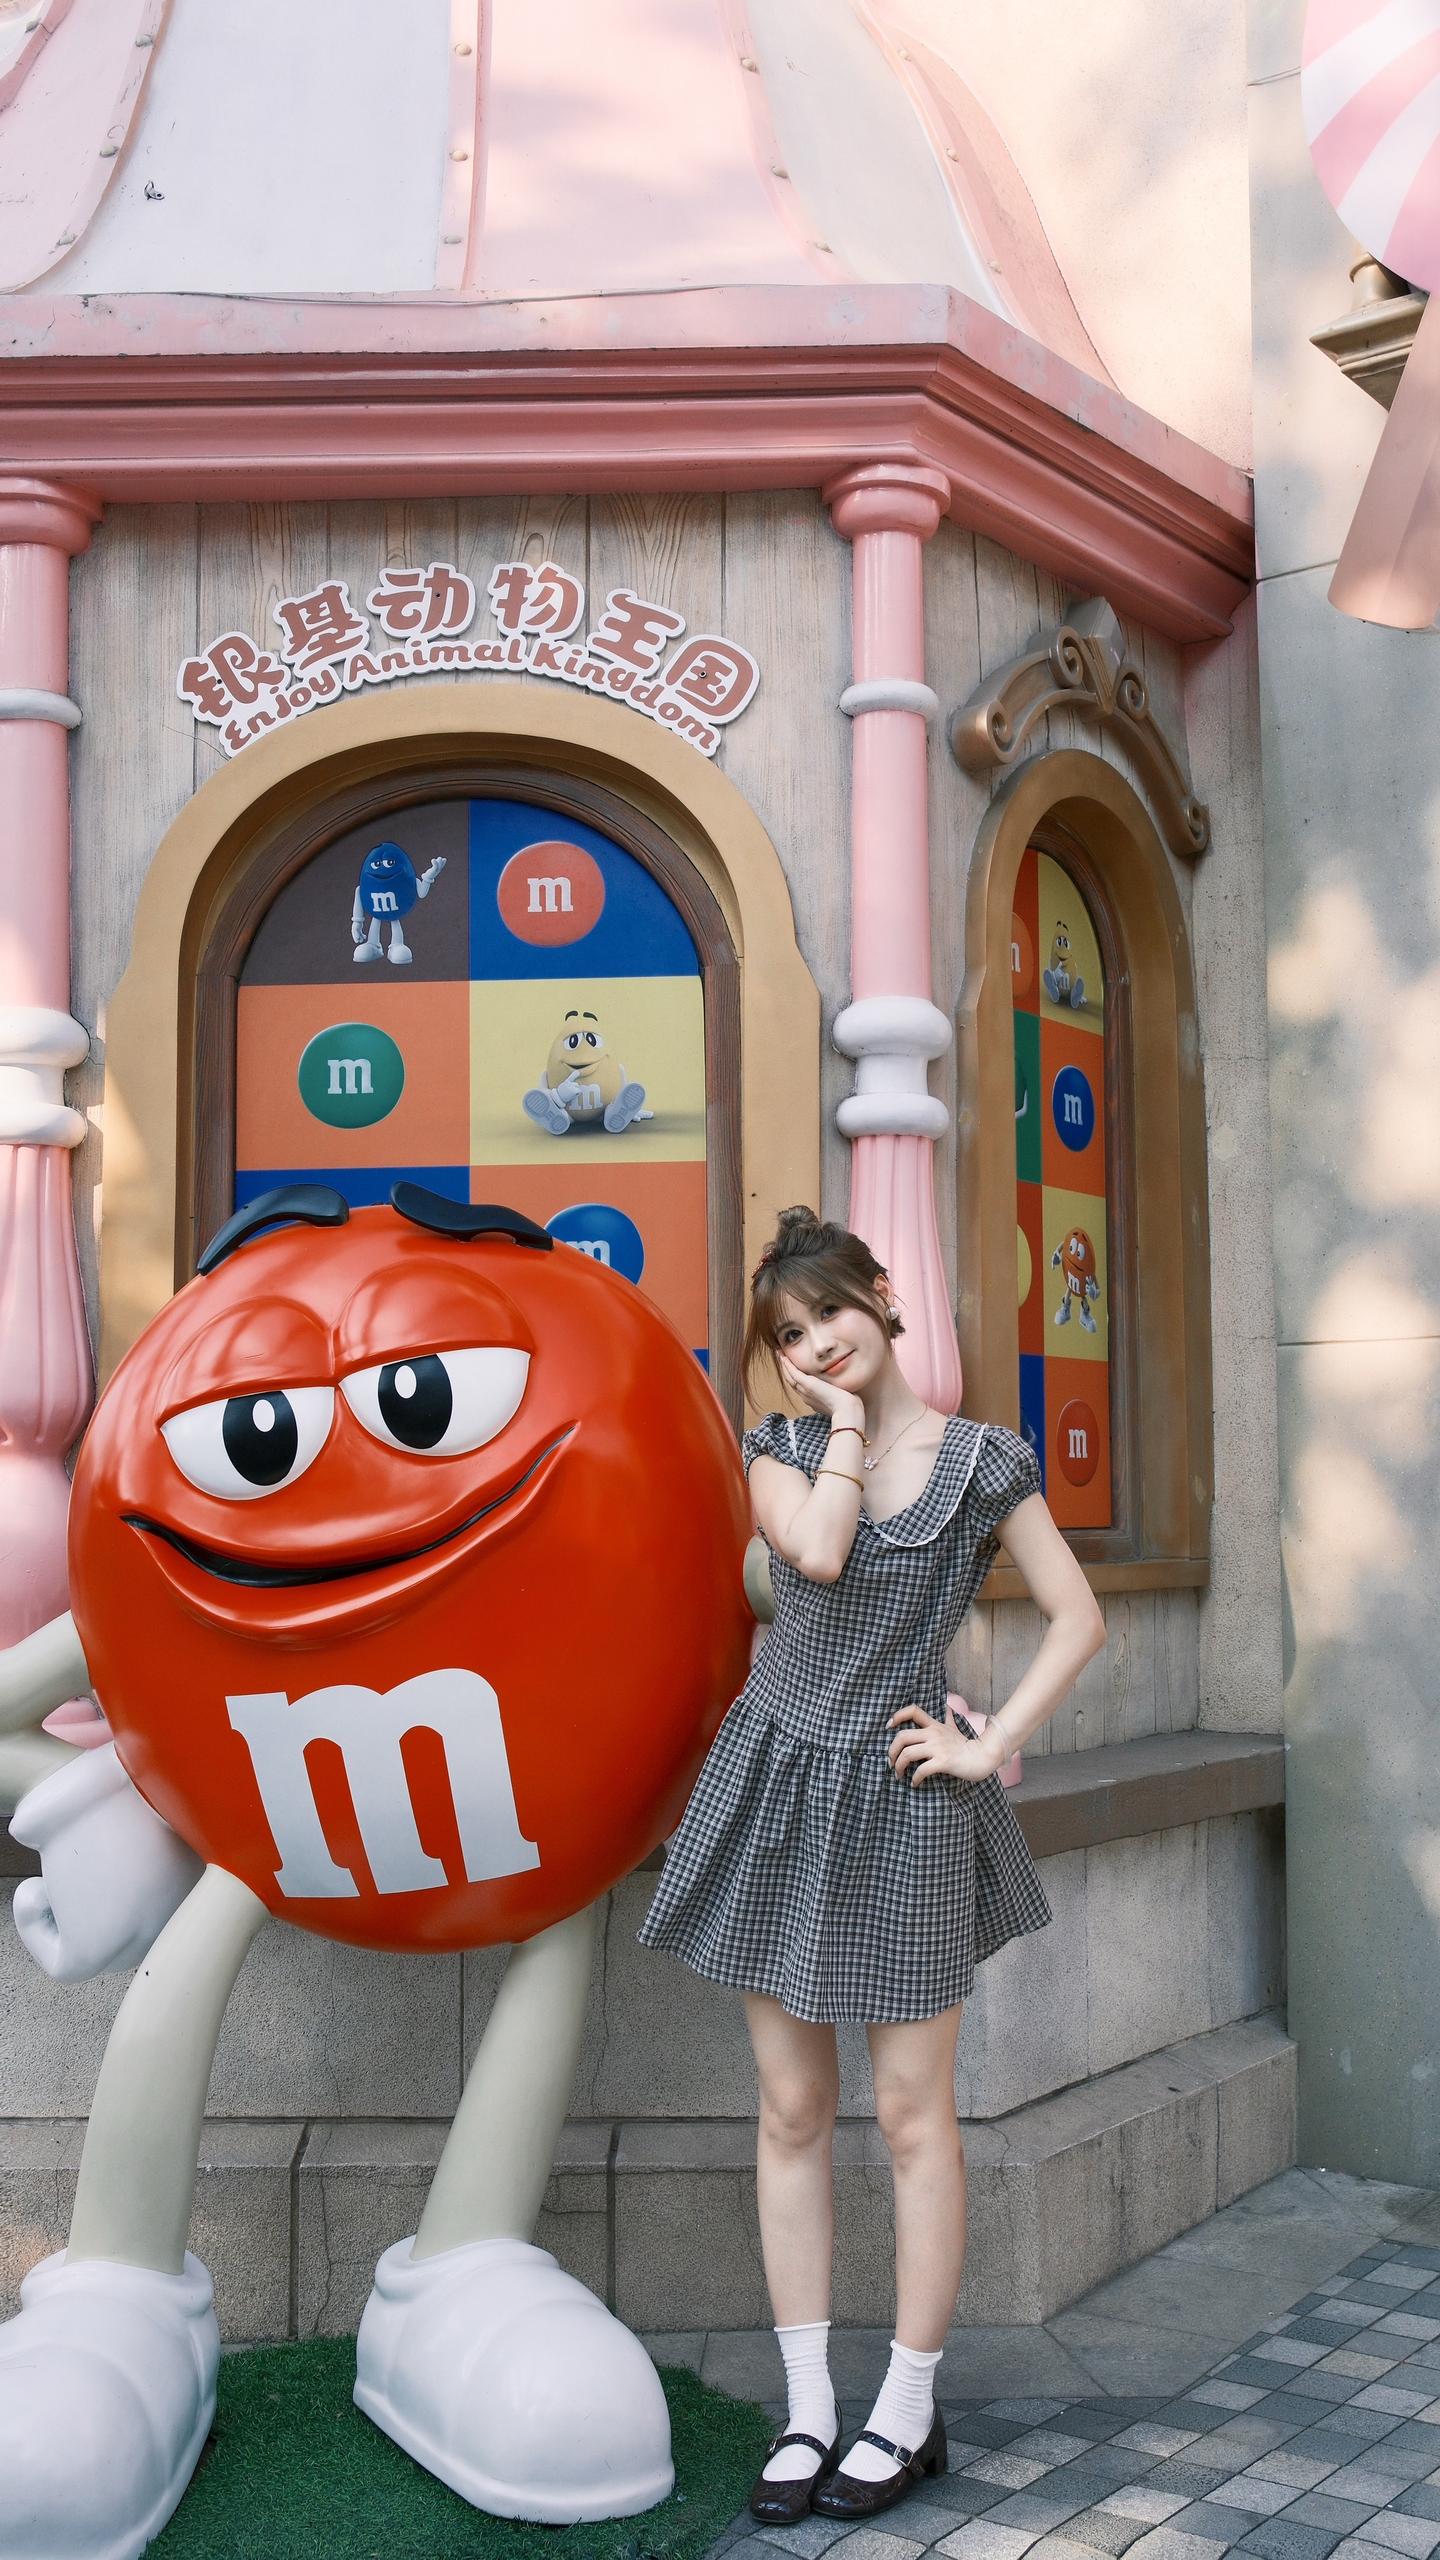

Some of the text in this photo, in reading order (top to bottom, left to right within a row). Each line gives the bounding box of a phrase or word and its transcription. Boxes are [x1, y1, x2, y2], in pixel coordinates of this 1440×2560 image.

[183, 566, 754, 718] 银基动物王国
[225, 639, 715, 750] Enjoy Animal Kingdom
[370, 890, 399, 913] m
[527, 875, 574, 913] m
[327, 1058, 374, 1095] m
[1063, 1092, 1083, 1126] m
[1067, 1271, 1081, 1295] m
[1068, 1428, 1088, 1459] m
[225, 1668, 541, 1898] m
